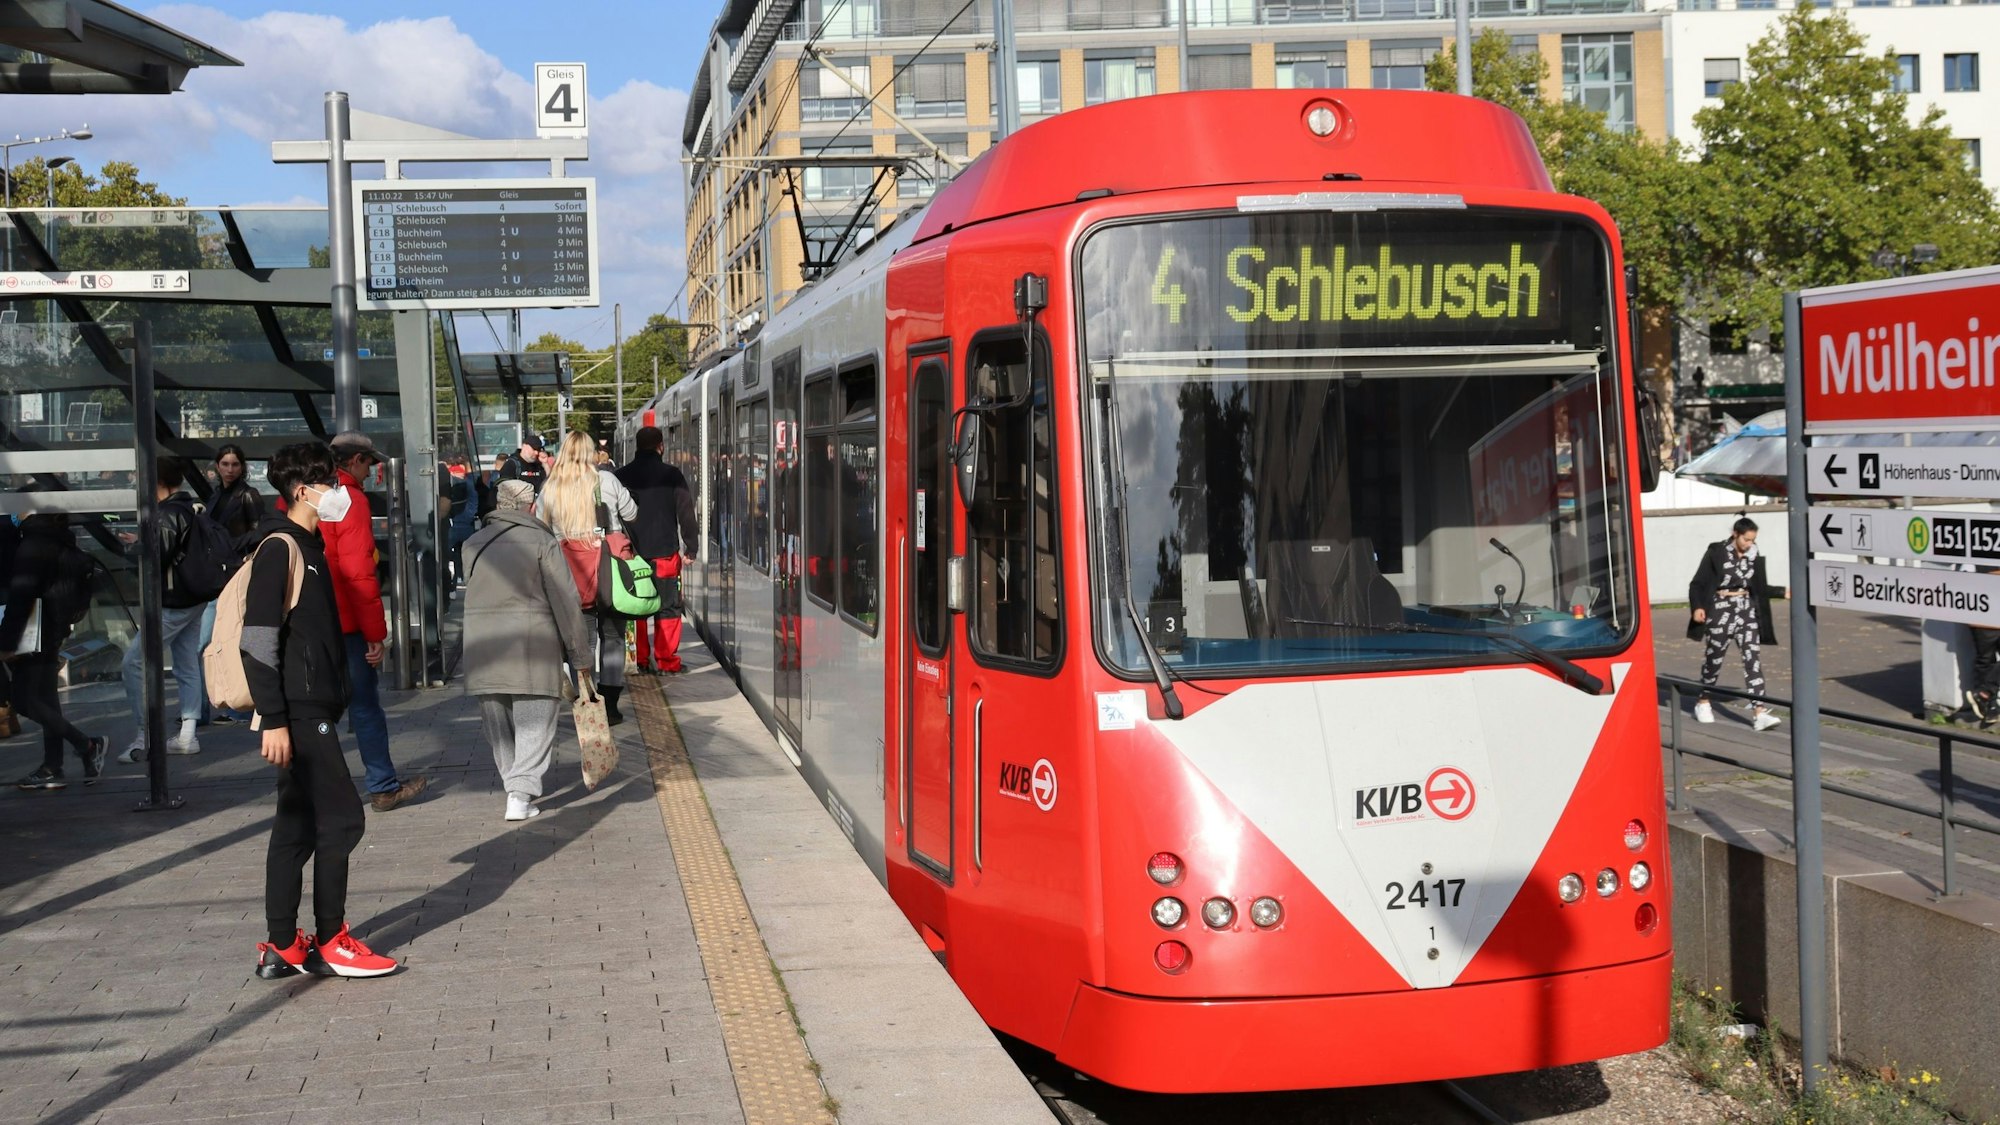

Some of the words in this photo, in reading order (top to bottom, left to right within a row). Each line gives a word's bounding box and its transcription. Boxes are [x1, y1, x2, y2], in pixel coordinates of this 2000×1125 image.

[546, 69, 574, 79] Gleis
[544, 84, 578, 122] 4
[368, 192, 403, 200] 11.10.22
[414, 192, 436, 200] 15:47
[438, 190, 454, 200] Uhr
[500, 190, 519, 199] Gleis
[574, 190, 582, 198] in
[378, 204, 384, 213] 4
[396, 204, 447, 214] Schlebusch
[499, 203, 505, 211] 4
[554, 202, 582, 211] Sofort
[378, 216, 384, 225] 4
[396, 215, 447, 225] Schlebusch
[500, 215, 506, 224] 4
[557, 214, 563, 222] 3
[566, 214, 583, 222] Min
[373, 228, 390, 238] E18
[397, 228, 442, 238] Buchheim
[500, 228, 506, 236] 1
[511, 226, 519, 236] U
[557, 226, 564, 235] 4
[566, 226, 583, 235] Min
[379, 241, 385, 250] 4
[398, 240, 448, 250] Schlebusch
[500, 239, 506, 248] 4
[558, 238, 564, 247] 9
[566, 238, 584, 247] Min
[374, 253, 392, 262] E18
[398, 252, 443, 262] Buchheim
[502, 251, 507, 260] 1
[512, 250, 520, 260] U
[553, 250, 564, 259] 14
[566, 250, 584, 259] Min
[380, 266, 386, 274] 4
[398, 264, 449, 274] Schlebusch
[501, 263, 508, 272] 4
[554, 262, 565, 271] 15
[566, 262, 584, 271] Min
[375, 278, 392, 286] E18
[399, 276, 444, 286] Buchheim
[502, 275, 508, 284] 1
[513, 274, 521, 284] U
[554, 274, 565, 283] 24
[567, 274, 585, 282] Min
[1151, 247, 1187, 324] 4
[1226, 242, 1541, 323] Schlebusch
[395, 290, 428, 299] halten?
[431, 288, 454, 298] Dann
[456, 288, 478, 300] steig
[480, 287, 492, 296] als
[494, 288, 513, 296] Bus-
[516, 287, 536, 296] oder
[365, 404, 372, 414] 3
[562, 398, 570, 408] 4
[1862, 458, 1876, 484] 4
[1884, 463, 1951, 480] Höhenhaus
[1934, 525, 1964, 550] 151
[1972, 527, 2000, 552] 152
[1852, 574, 1990, 614] Bezirksrathaus
[1166, 616, 1176, 633] 3
[1000, 762, 1032, 794] KVB
[1356, 783, 1422, 820] KVB
[1385, 878, 1466, 910] 2417
[1429, 926, 1435, 941] 1
